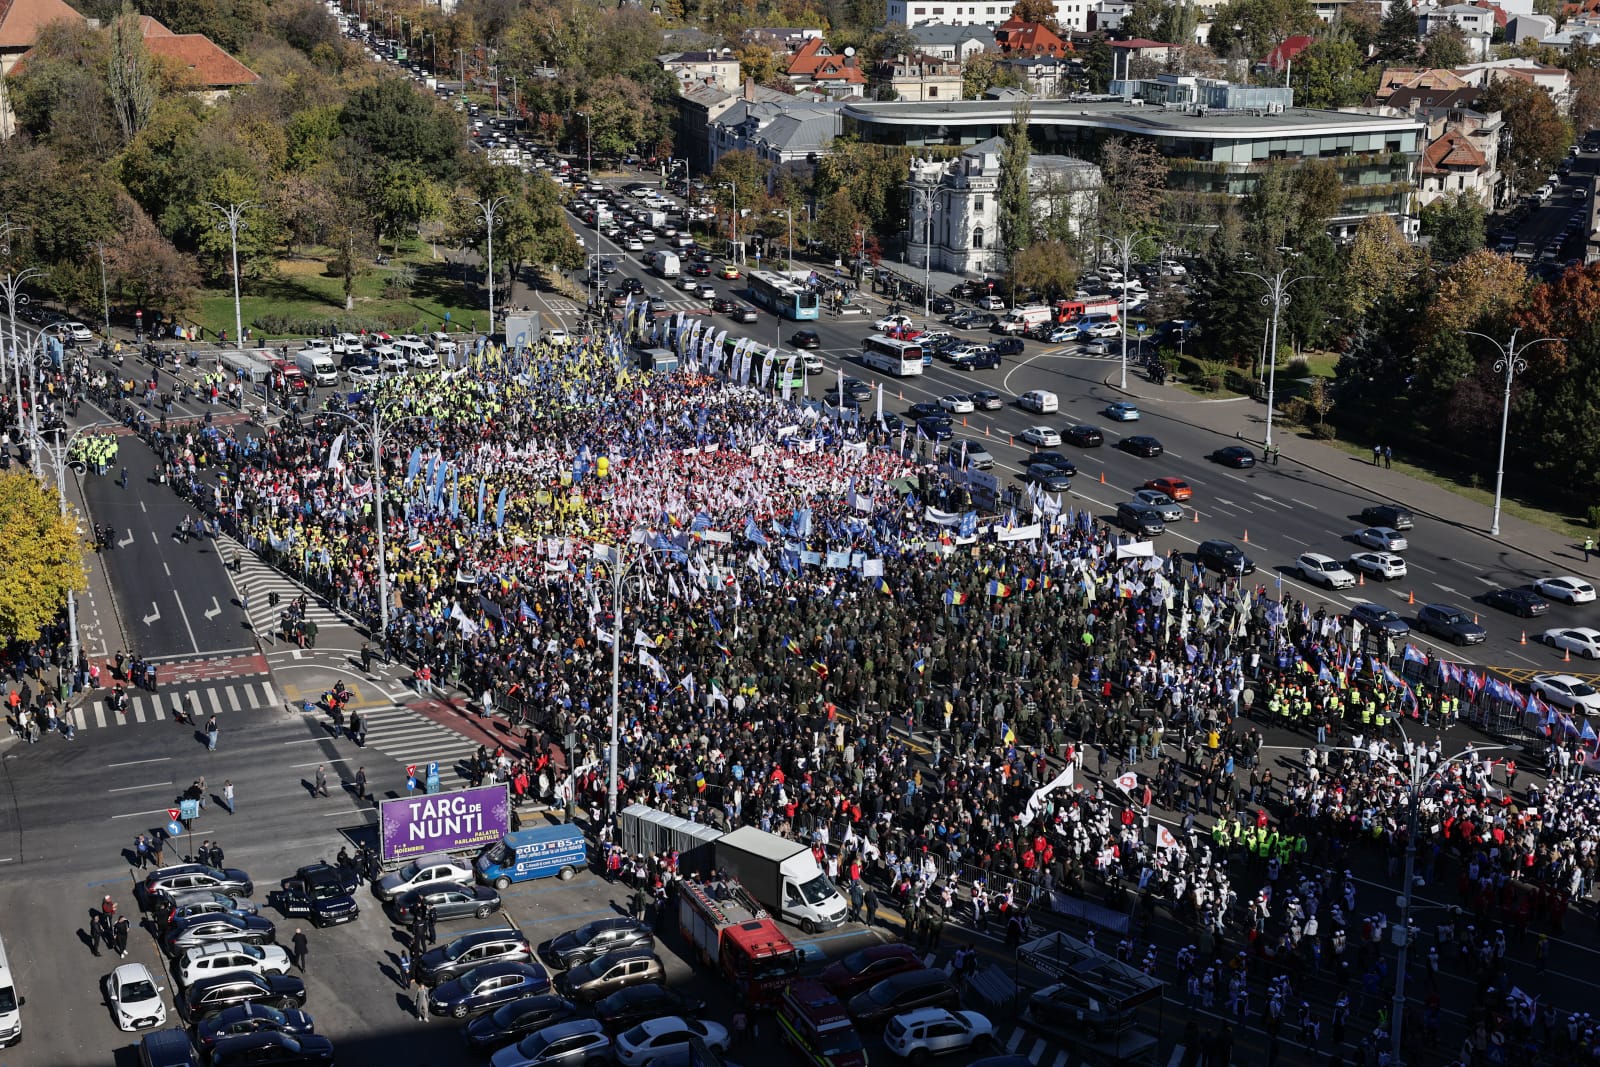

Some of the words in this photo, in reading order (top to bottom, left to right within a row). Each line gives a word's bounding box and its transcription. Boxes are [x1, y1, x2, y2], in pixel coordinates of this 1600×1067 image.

[430, 763, 436, 775] P
[409, 797, 467, 821] TARG
[469, 803, 482, 813] DE
[474, 829, 500, 838] PALATUL
[454, 834, 500, 846] PARLAMENTULUI
